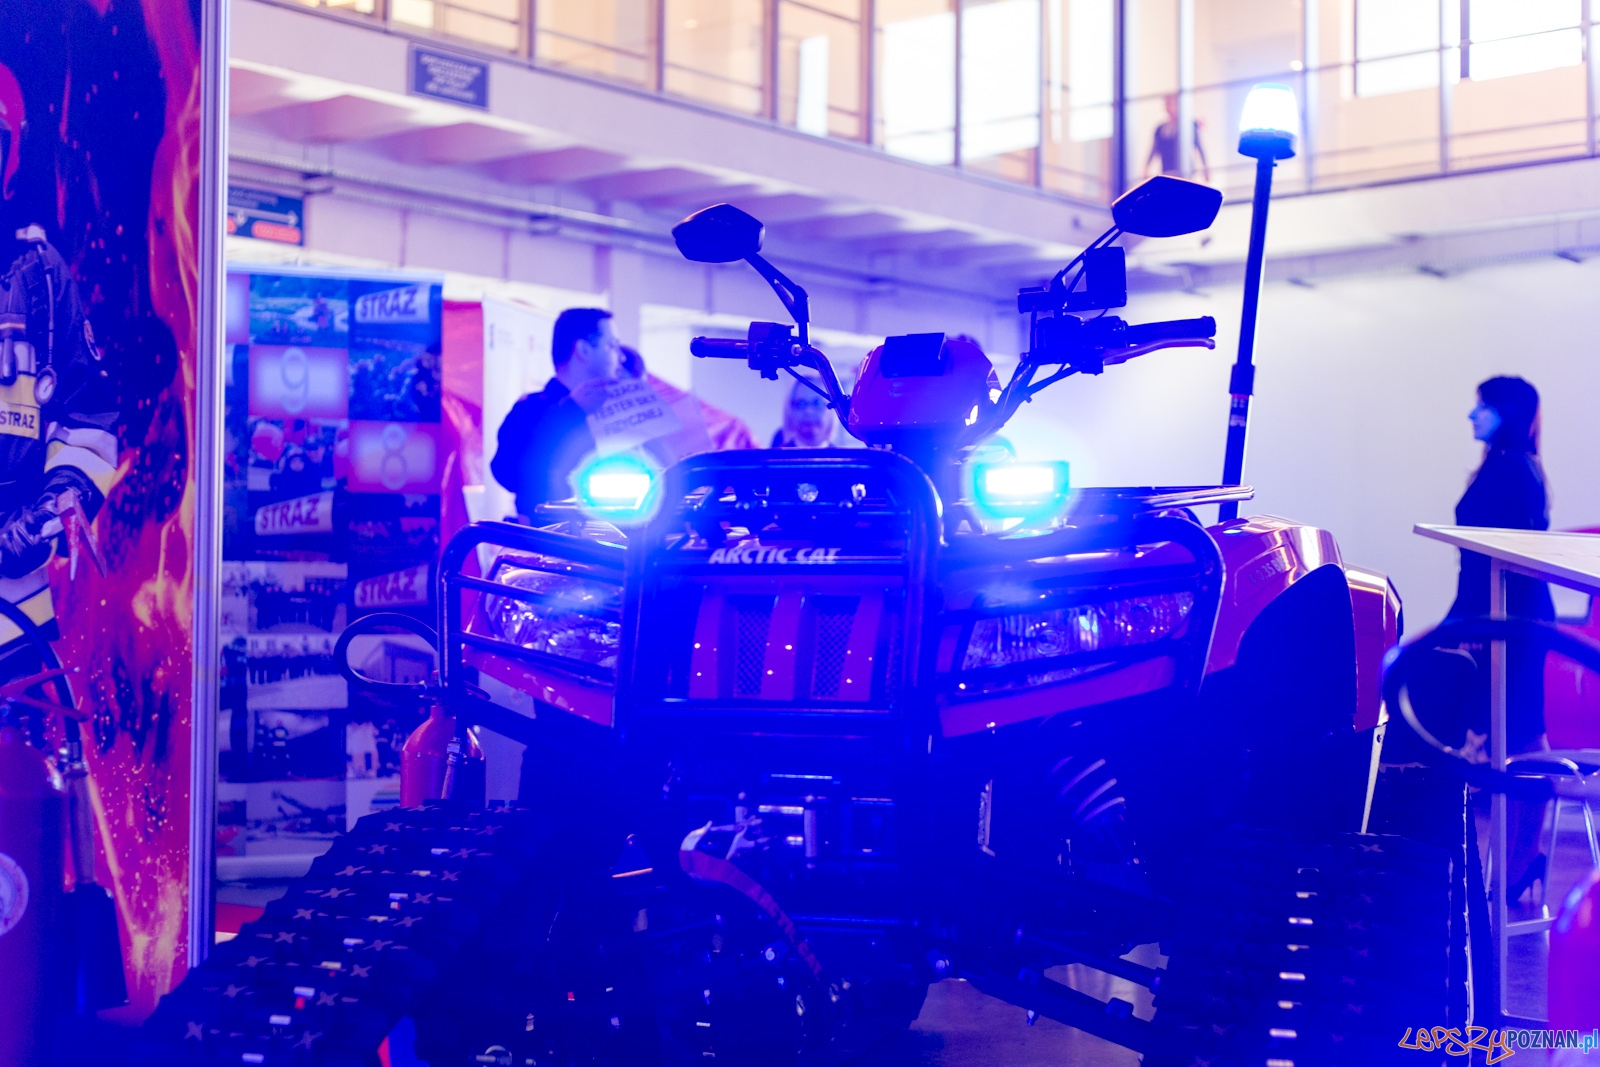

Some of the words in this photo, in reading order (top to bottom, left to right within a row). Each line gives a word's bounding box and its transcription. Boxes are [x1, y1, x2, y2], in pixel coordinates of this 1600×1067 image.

[280, 346, 309, 415] 9
[381, 423, 407, 491] 8
[708, 547, 793, 565] ARCTIC
[795, 547, 842, 565] CAT
